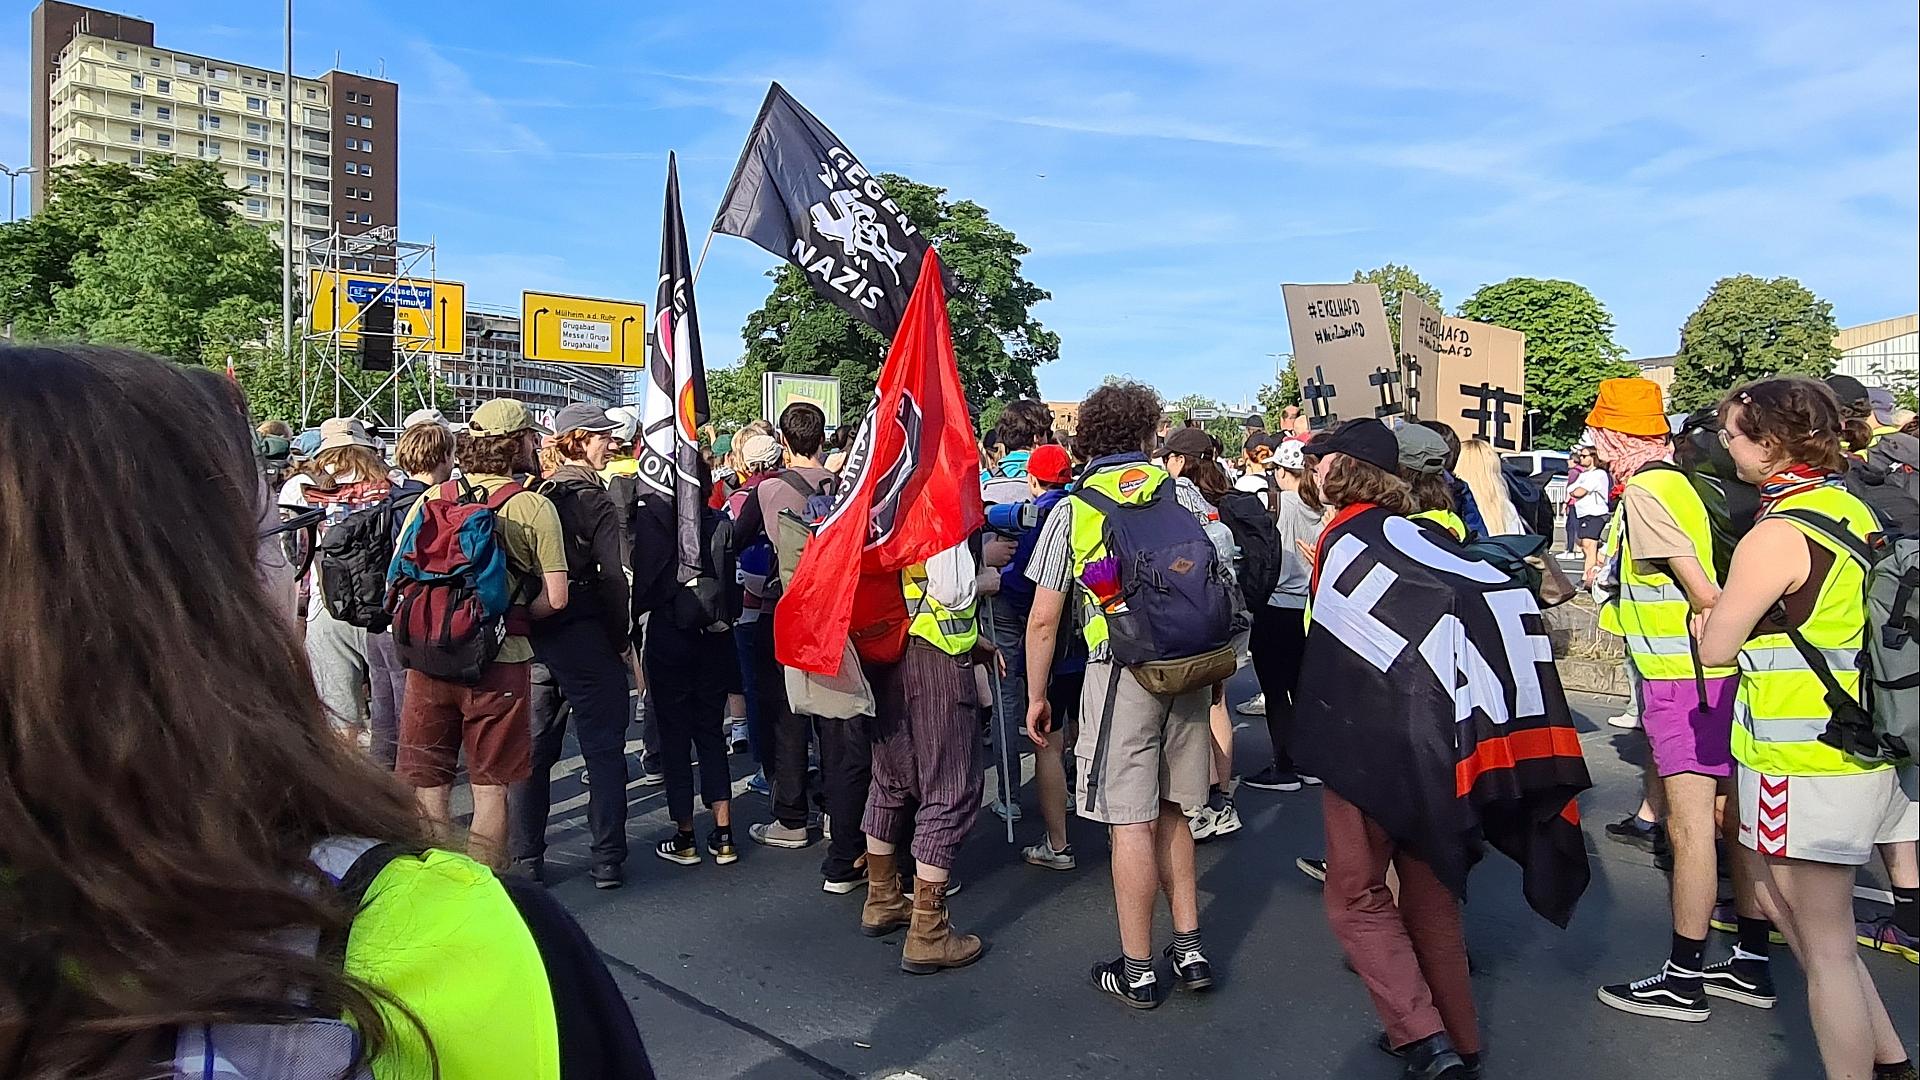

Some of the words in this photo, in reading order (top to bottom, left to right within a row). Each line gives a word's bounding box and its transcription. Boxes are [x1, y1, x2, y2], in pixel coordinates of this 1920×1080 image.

[828, 146, 917, 237] GEGEN
[791, 238, 885, 310] NAZIS
[562, 321, 595, 331] Grugabad
[562, 331, 584, 339] Messe
[590, 333, 609, 342] Gruga
[562, 340, 599, 349] Grugahalle
